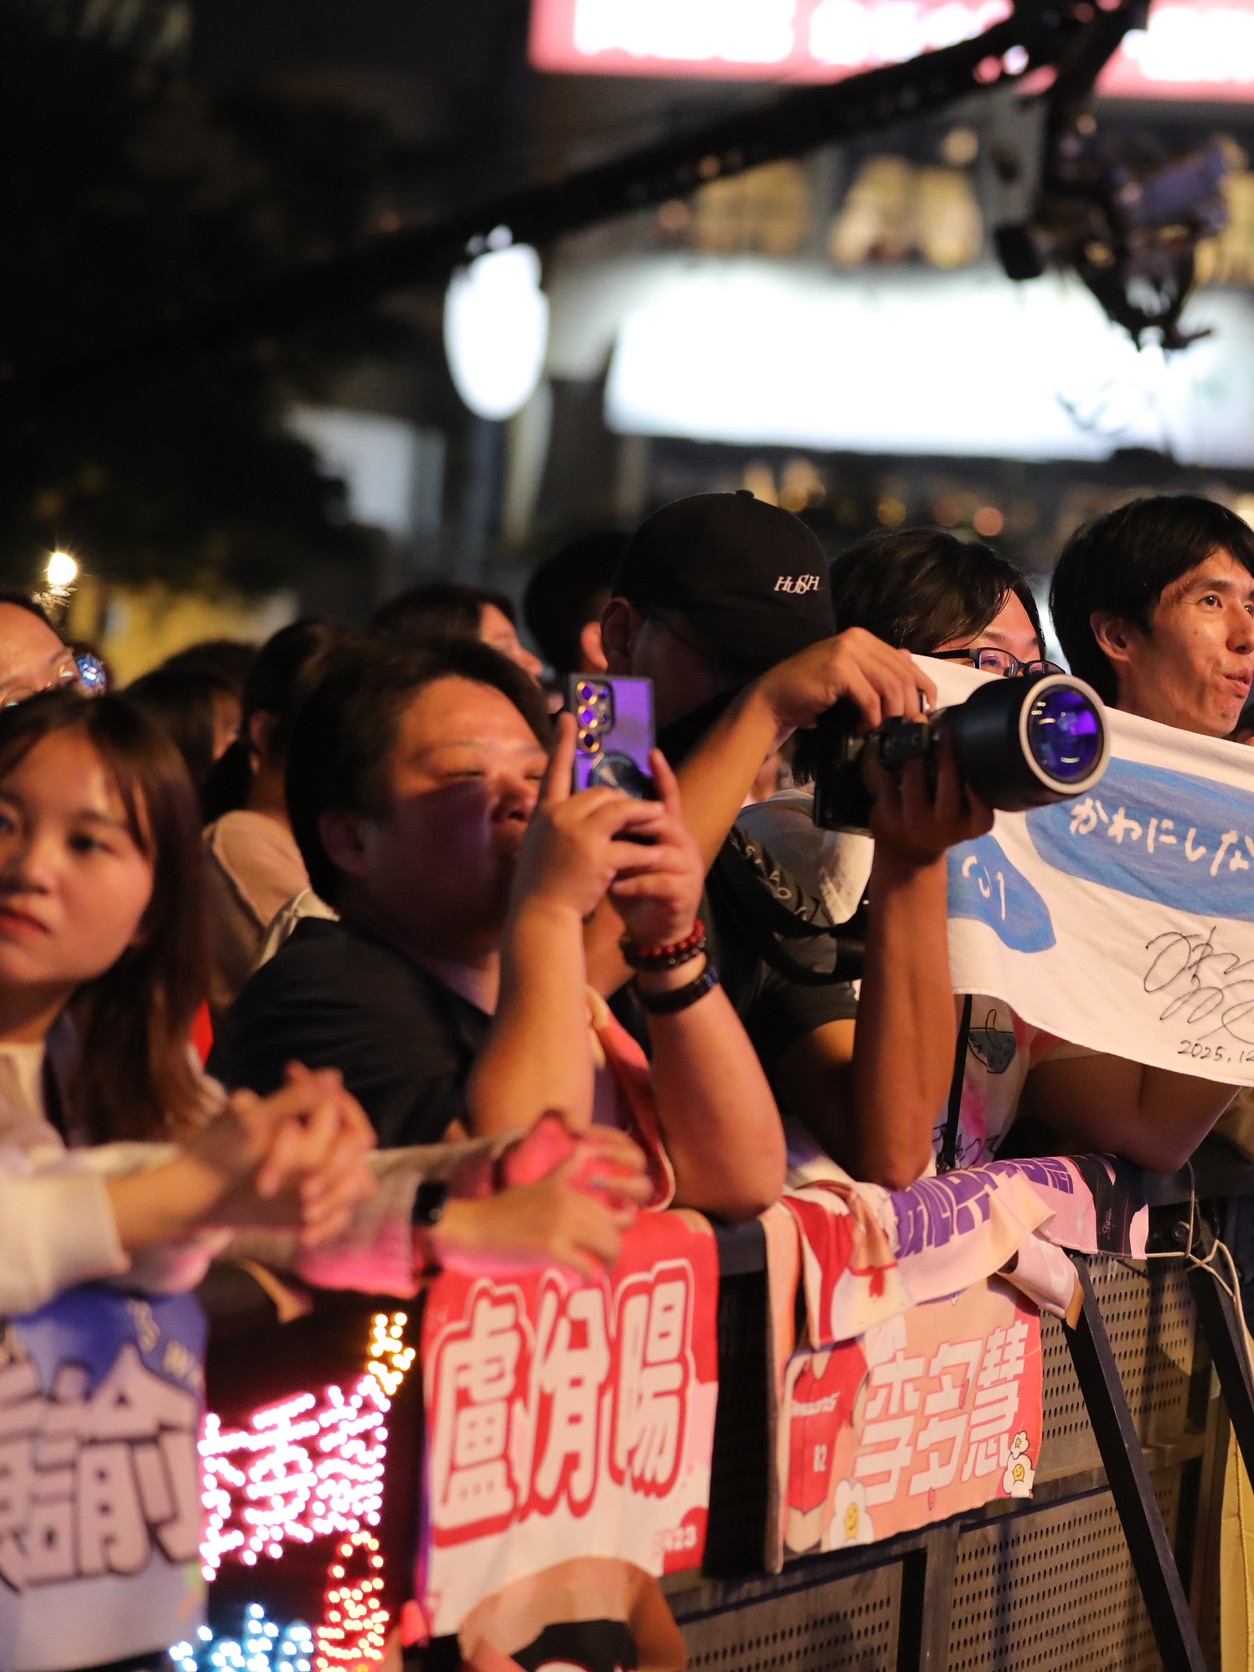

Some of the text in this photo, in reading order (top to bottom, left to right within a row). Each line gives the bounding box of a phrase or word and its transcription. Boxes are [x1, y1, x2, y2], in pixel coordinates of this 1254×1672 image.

[774, 574, 820, 594] HUSH
[851, 1319, 1030, 1506] 李多慧
